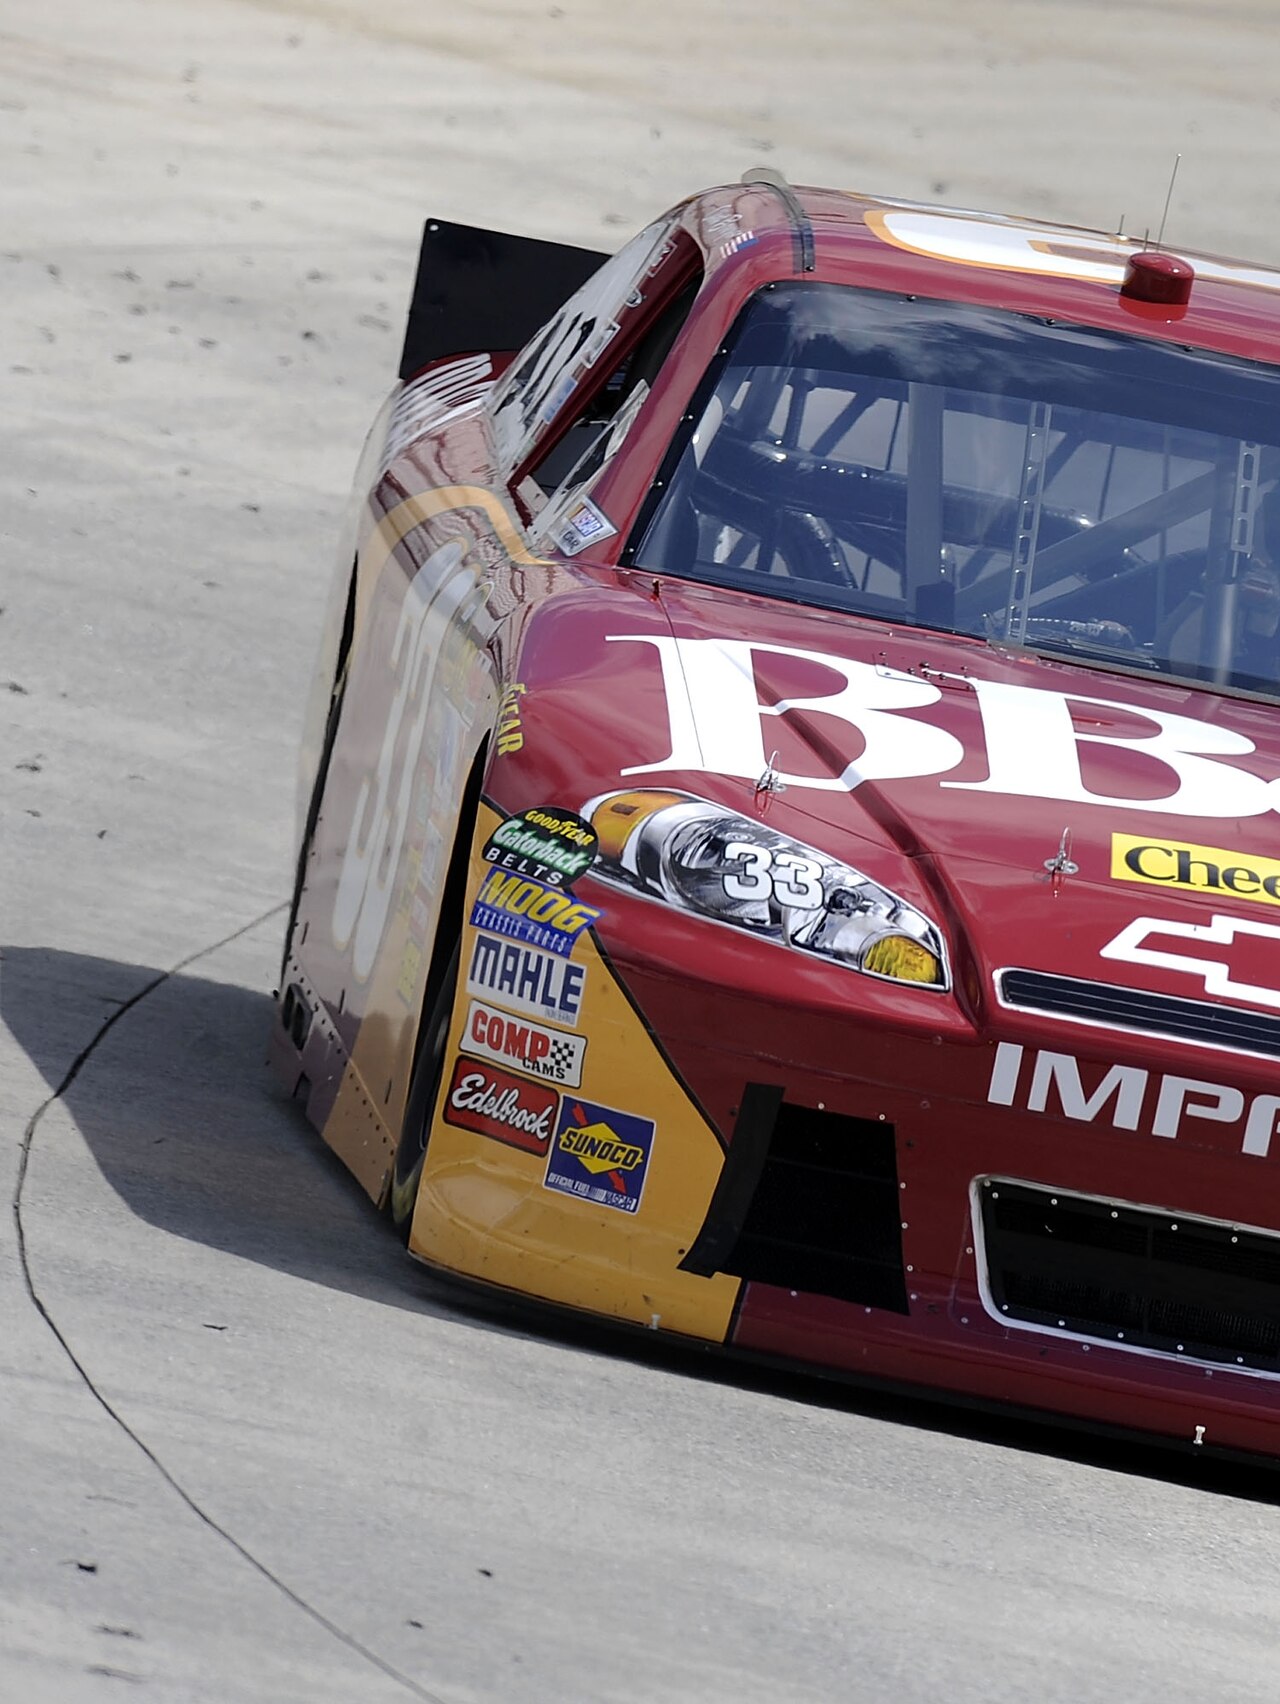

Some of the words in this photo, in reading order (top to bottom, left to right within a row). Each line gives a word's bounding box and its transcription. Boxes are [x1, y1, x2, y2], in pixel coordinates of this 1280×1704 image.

[493, 819, 590, 876] Gatorback
[525, 810, 595, 846] GOODYEAR
[485, 847, 563, 885] BELTS
[722, 841, 825, 911] 33
[478, 871, 600, 934] MOOG
[470, 934, 584, 1013] MAHLE
[472, 1010, 550, 1062] COMP
[522, 1057, 566, 1080] CAMS
[452, 1074, 553, 1139] Edelbrock
[562, 1131, 640, 1167] SUNOCO
